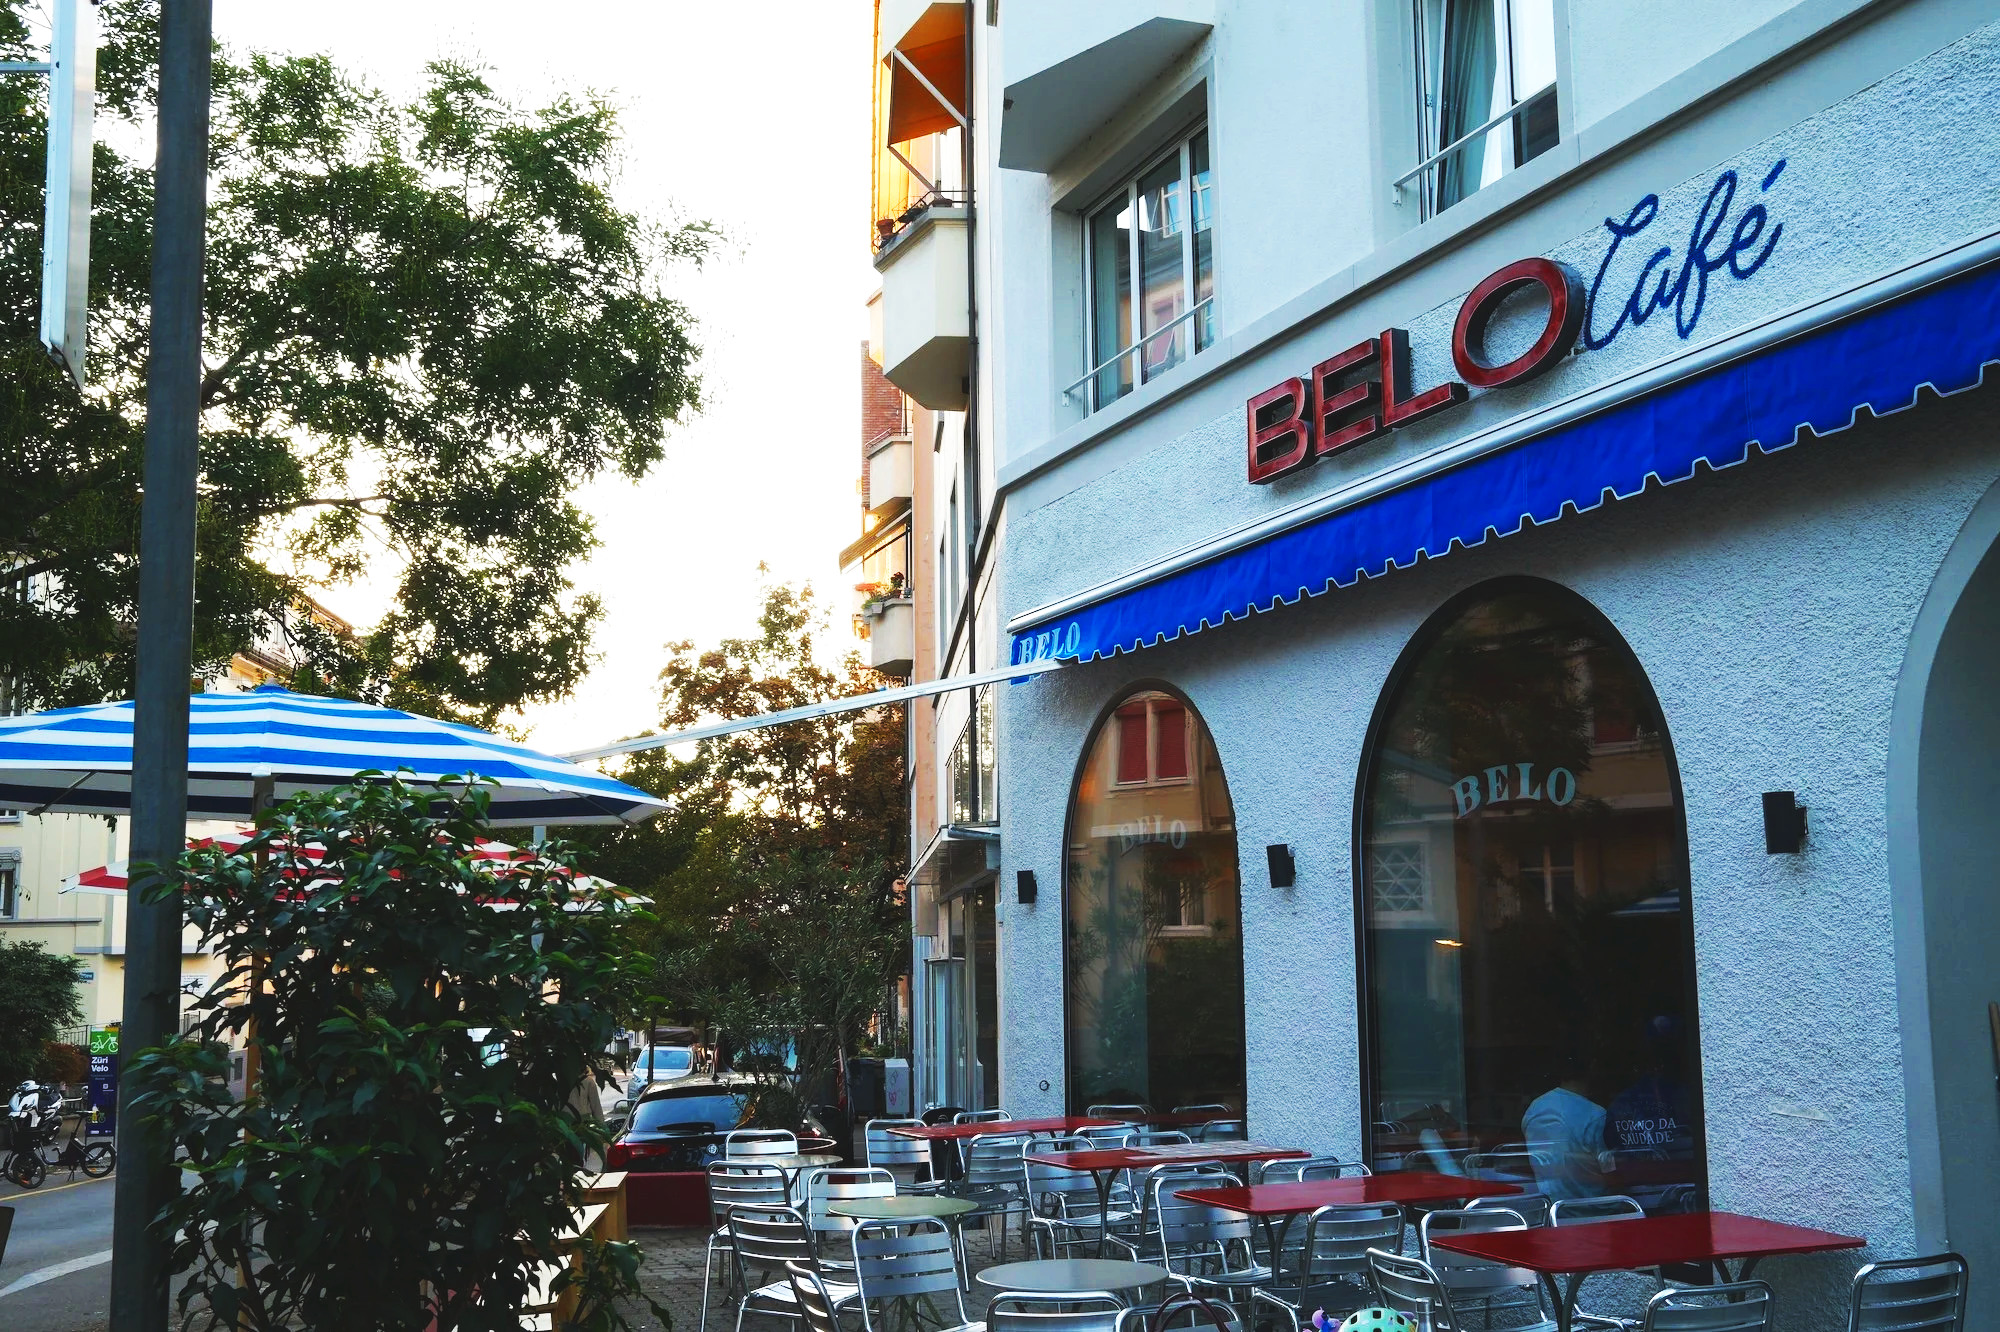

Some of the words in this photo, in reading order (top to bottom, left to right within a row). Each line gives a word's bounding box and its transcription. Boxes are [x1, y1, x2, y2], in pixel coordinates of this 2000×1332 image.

[1246, 257, 1580, 485] BELO
[1585, 159, 1786, 351] Café
[1018, 622, 1080, 663] BELO
[1450, 763, 1576, 820] BELO
[1119, 814, 1187, 857] BELO
[91, 1056, 109, 1064] Züri
[1620, 1130, 1674, 1145] SAUDADE
[1659, 1117, 1677, 1130] DA
